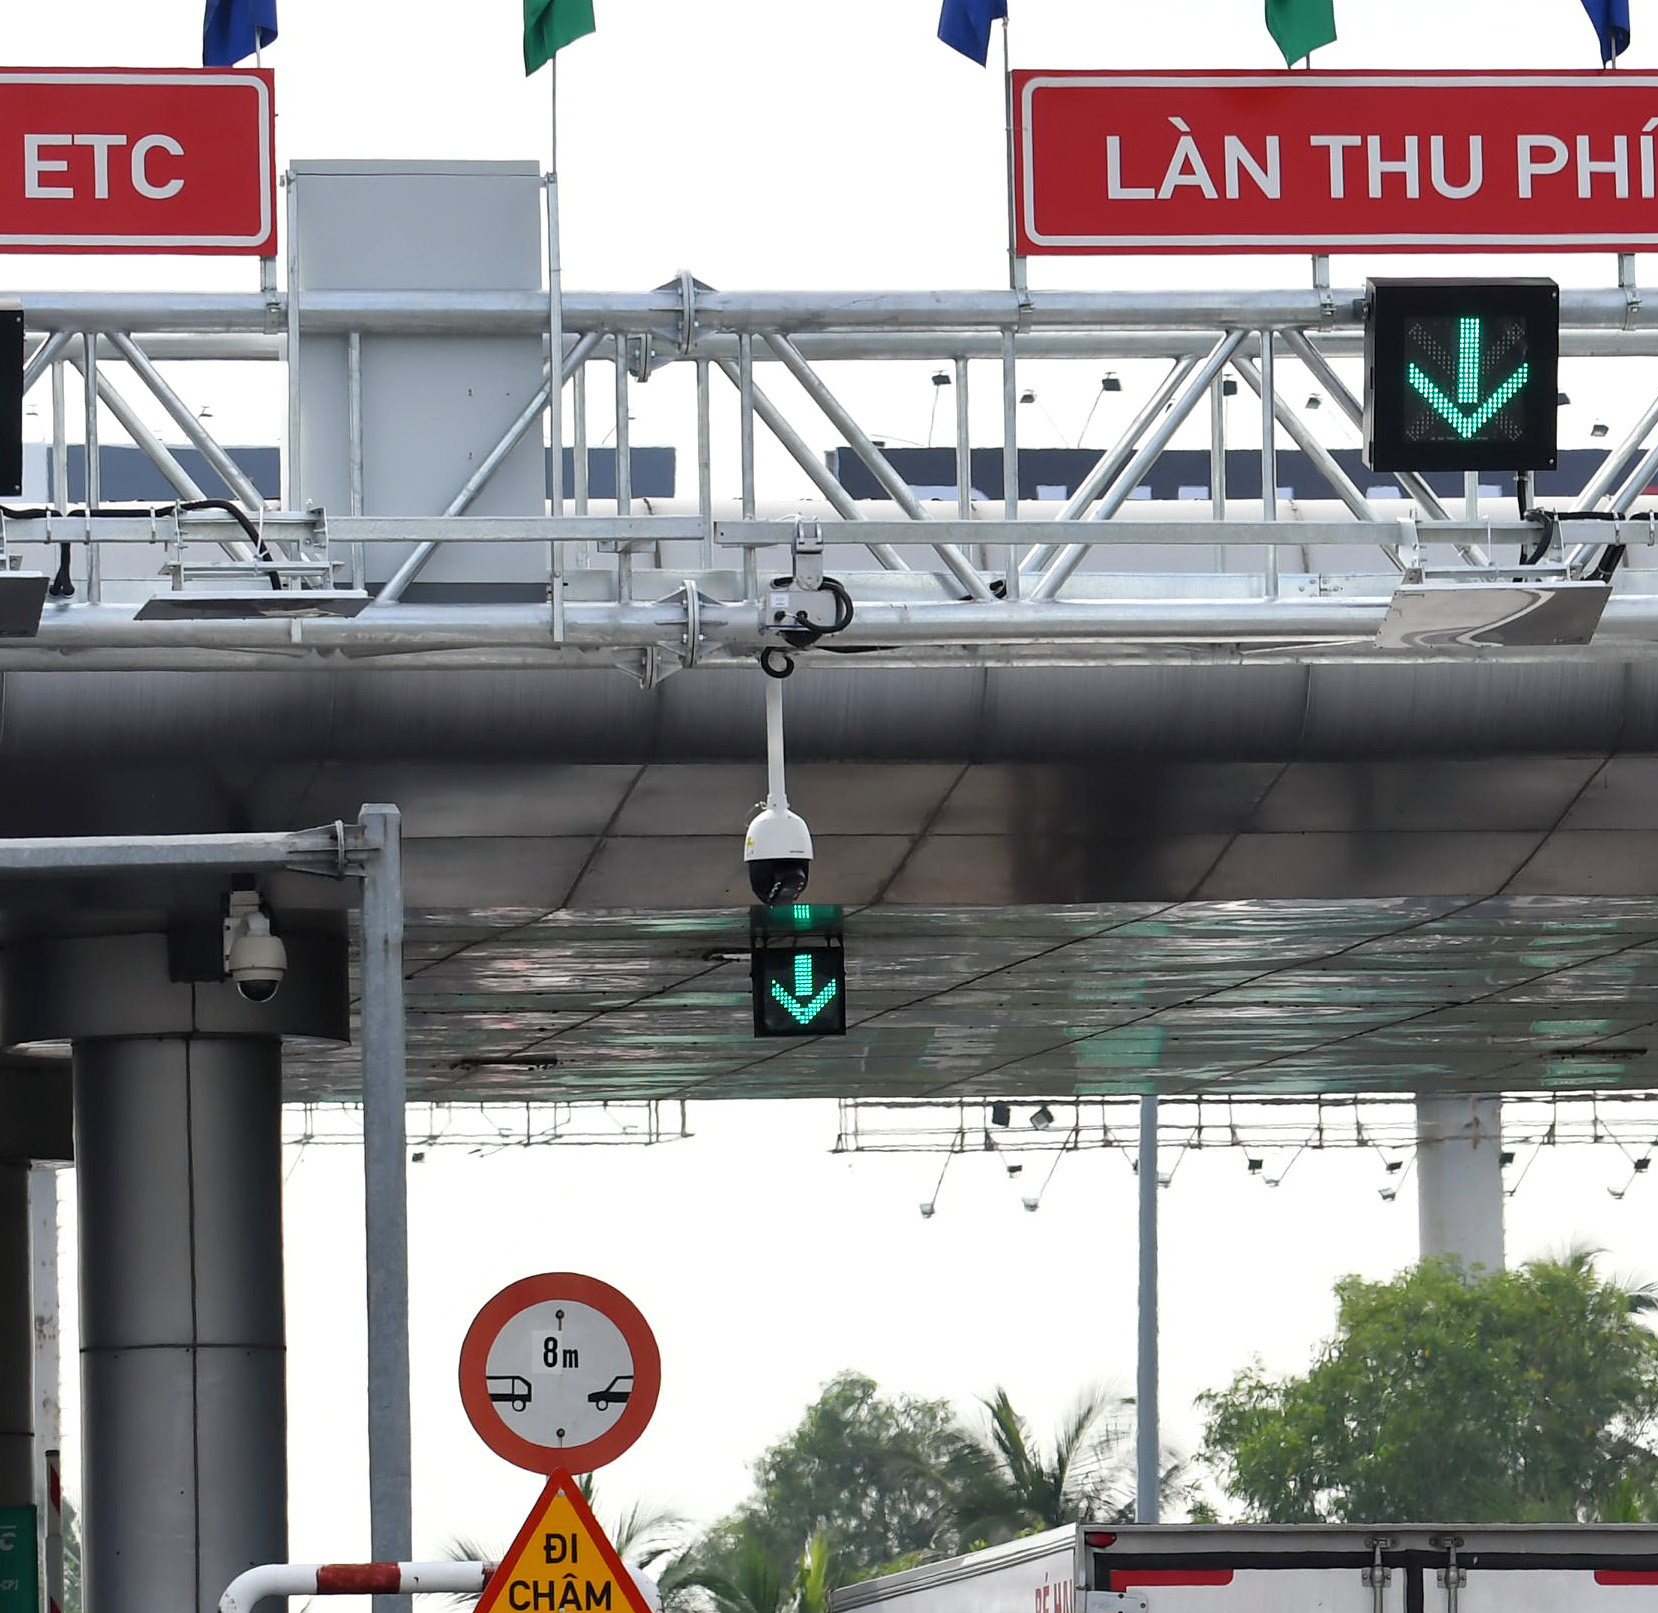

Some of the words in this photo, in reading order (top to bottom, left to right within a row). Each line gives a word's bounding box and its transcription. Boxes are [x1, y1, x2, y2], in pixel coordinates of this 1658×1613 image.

[23, 134, 185, 199] ETC
[1107, 117, 1280, 199] LÀN
[1310, 135, 1482, 198] THU
[1517, 117, 1655, 198] PHÍ
[544, 1534, 577, 1563] ĐI
